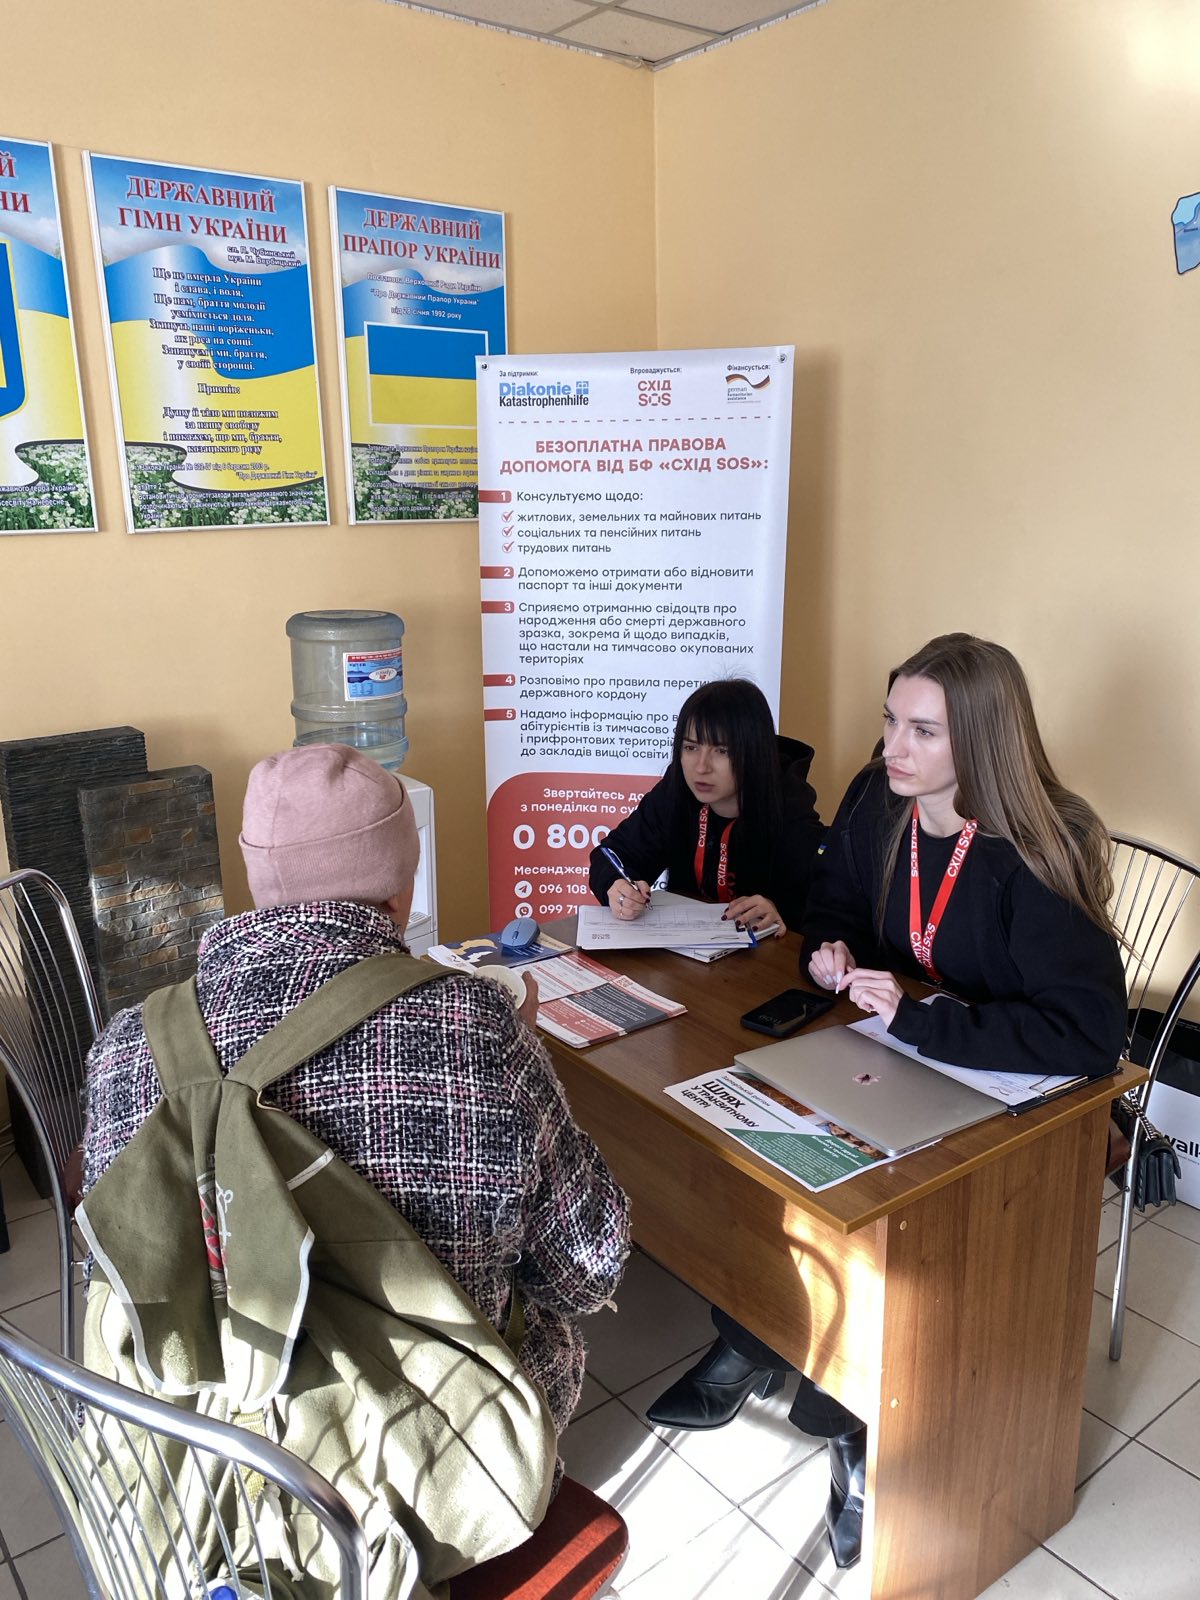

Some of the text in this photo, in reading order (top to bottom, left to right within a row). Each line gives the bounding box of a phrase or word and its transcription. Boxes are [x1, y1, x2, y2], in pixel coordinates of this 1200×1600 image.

[126, 176, 275, 213] ДЕРЖАВНИЙ
[118, 207, 288, 244] ГІМН УКРАЇНИ
[363, 208, 481, 241] ДЕРЖАВНИЙ
[342, 234, 501, 269] ПРАПОР УКРАЇНИ
[427, 294, 452, 304] Прапор
[431, 310, 446, 318] 1992
[447, 312, 462, 320] року
[499, 370, 539, 378] За підтримки:
[629, 367, 683, 376] Впроваджується:
[726, 364, 771, 372] Фінансується:
[499, 381, 572, 396] Diakonie
[637, 380, 672, 392] СХІД
[499, 394, 589, 408] Katastrophenhilfe
[638, 392, 672, 406] SOS
[535, 437, 726, 453] БЕЗОПЛАТНА ПРАВОВА
[499, 456, 769, 475] ДОПОМОГА ВІД БФ «СХІД SOS»:
[516, 491, 602, 503] Консультуємо
[606, 490, 643, 503] щодо:
[517, 510, 761, 523] житлових, земельних та майнових питань
[517, 526, 701, 539] соціальних та пенсійних питань
[517, 543, 611, 555] трудових питань
[503, 566, 754, 579] 2 Допоможемо отримати або відновити
[518, 579, 683, 593] паспорт та інші документи
[504, 602, 737, 615] 3 Сприяємо отриманню свідоцтв про
[518, 615, 746, 629] народження або смерті державного
[518, 627, 730, 642] зразка, зокрема й щодо випадків,
[519, 642, 754, 656] що настали на тимчасово окупованих
[519, 653, 584, 667] територіях
[505, 675, 710, 690] 4 Розповімо про правила перети
[519, 688, 647, 702] державного кордону
[505, 709, 513, 719] 5
[520, 709, 567, 721] Надамо
[570, 709, 643, 722] інформацію
[646, 713, 669, 724] про
[520, 721, 590, 734] абітурієнтів
[593, 722, 602, 732] із
[605, 725, 669, 734] тимчасово
[527, 734, 615, 747] прифронтових
[520, 747, 669, 760] до закладів вищої освіти
[543, 788, 625, 801] Звертайтесь
[520, 801, 638, 815] з понеділка по су
[512, 824, 536, 850] 0
[947, 849, 965, 877] СХІД
[514, 865, 590, 877] Месенджер
[538, 884, 587, 895] 096 108
[539, 904, 563, 914] 099
[681, 1089, 712, 1109] ЦЕНТРІ
[698, 1088, 760, 1128] ТРАНЗИТНОМУ
